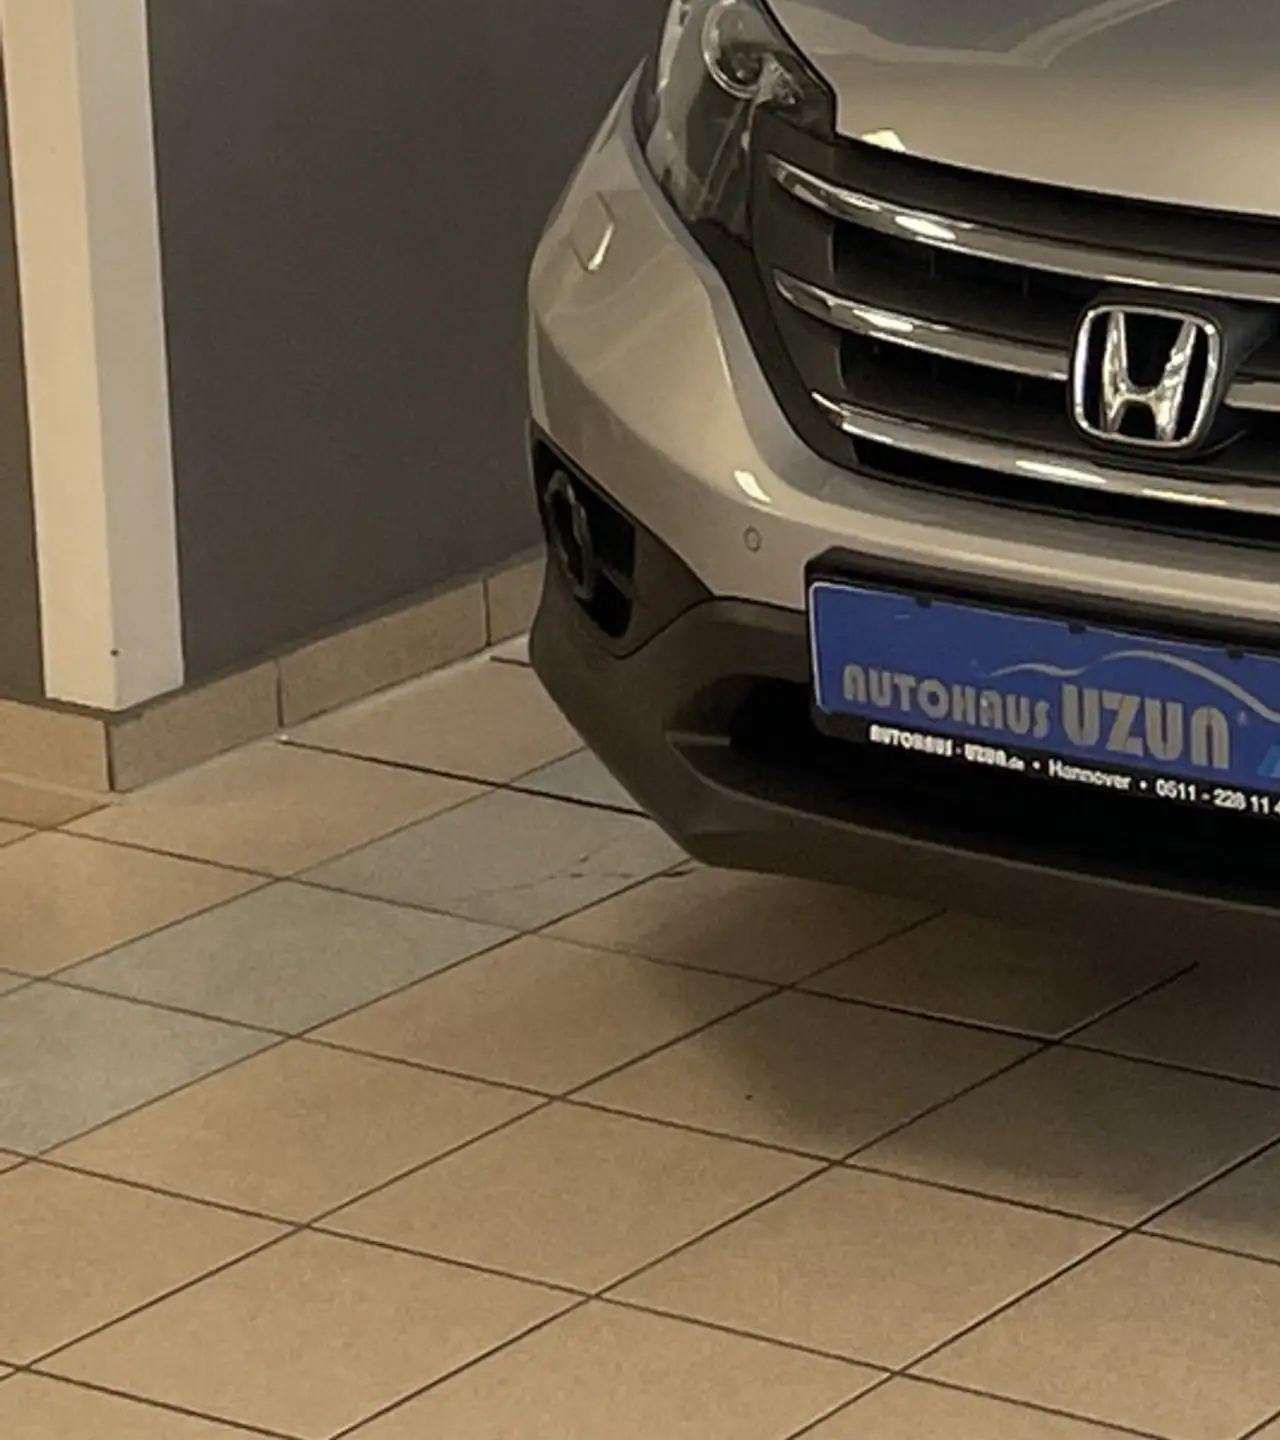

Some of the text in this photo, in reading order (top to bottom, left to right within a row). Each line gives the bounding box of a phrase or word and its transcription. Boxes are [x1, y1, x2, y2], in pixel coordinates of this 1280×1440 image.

[842, 662, 1232, 771] AUTOHAUS UZUN
[1048, 759, 1132, 791] Hannover
